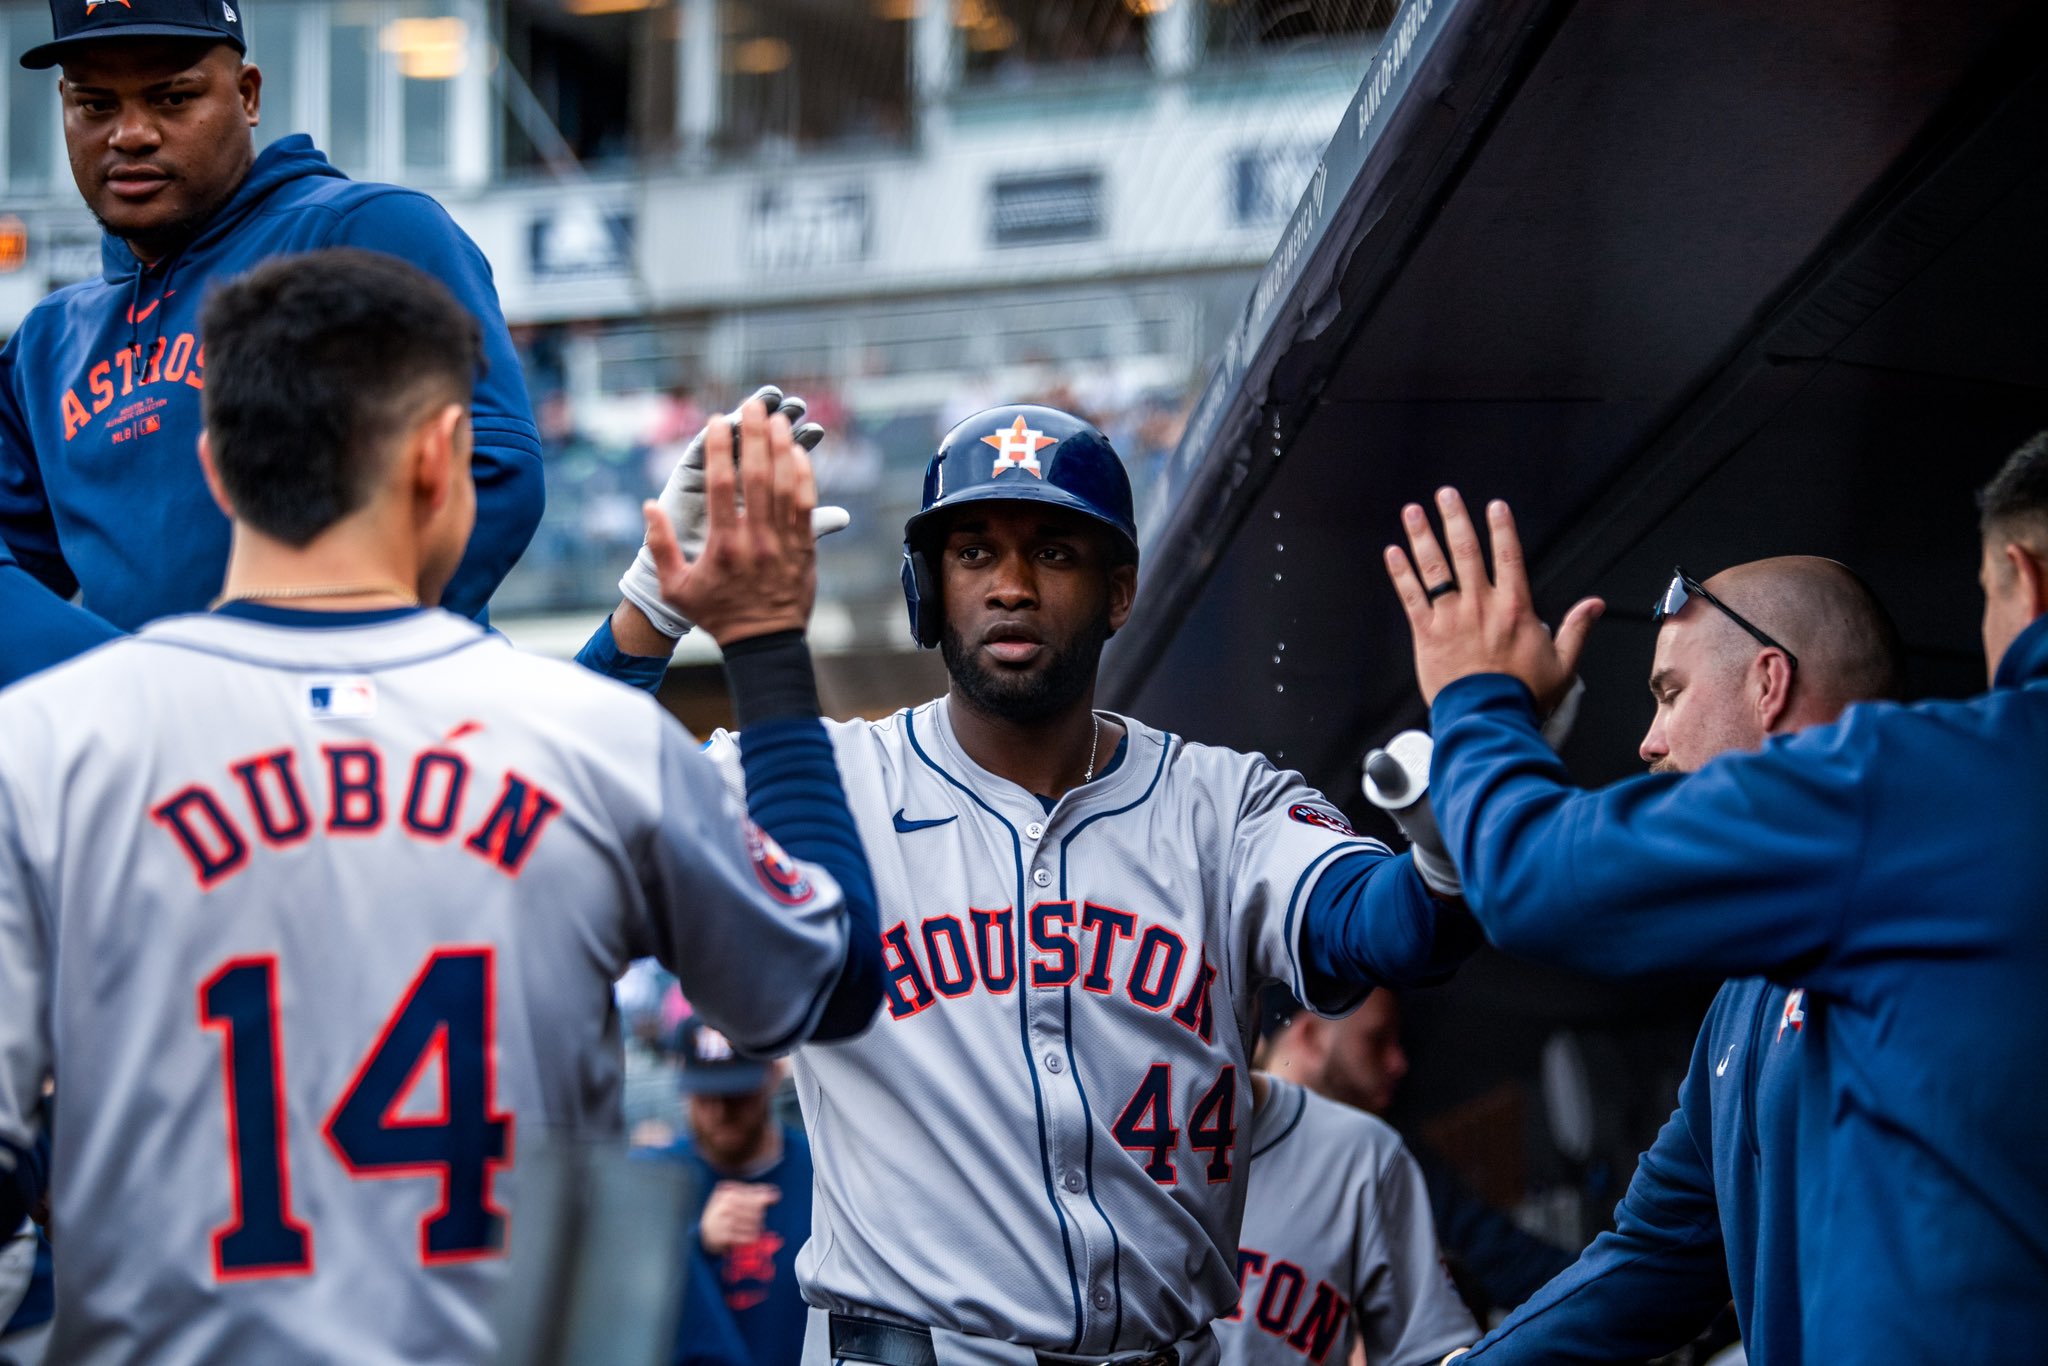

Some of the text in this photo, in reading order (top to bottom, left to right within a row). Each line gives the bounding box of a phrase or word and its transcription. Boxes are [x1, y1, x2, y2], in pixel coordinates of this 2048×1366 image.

[1359, 70, 1381, 141] BANK
[1382, 48, 1392, 96] OF
[1275, 253, 1284, 293] OF
[1283, 200, 1313, 280] AMERICA
[112, 428, 132, 444] MLB
[993, 428, 1043, 471] H
[149, 720, 563, 893] DUBÓN
[881, 900, 1217, 1046] HOUSTON
[196, 942, 516, 1284] 14
[1111, 1062, 1237, 1185] 44
